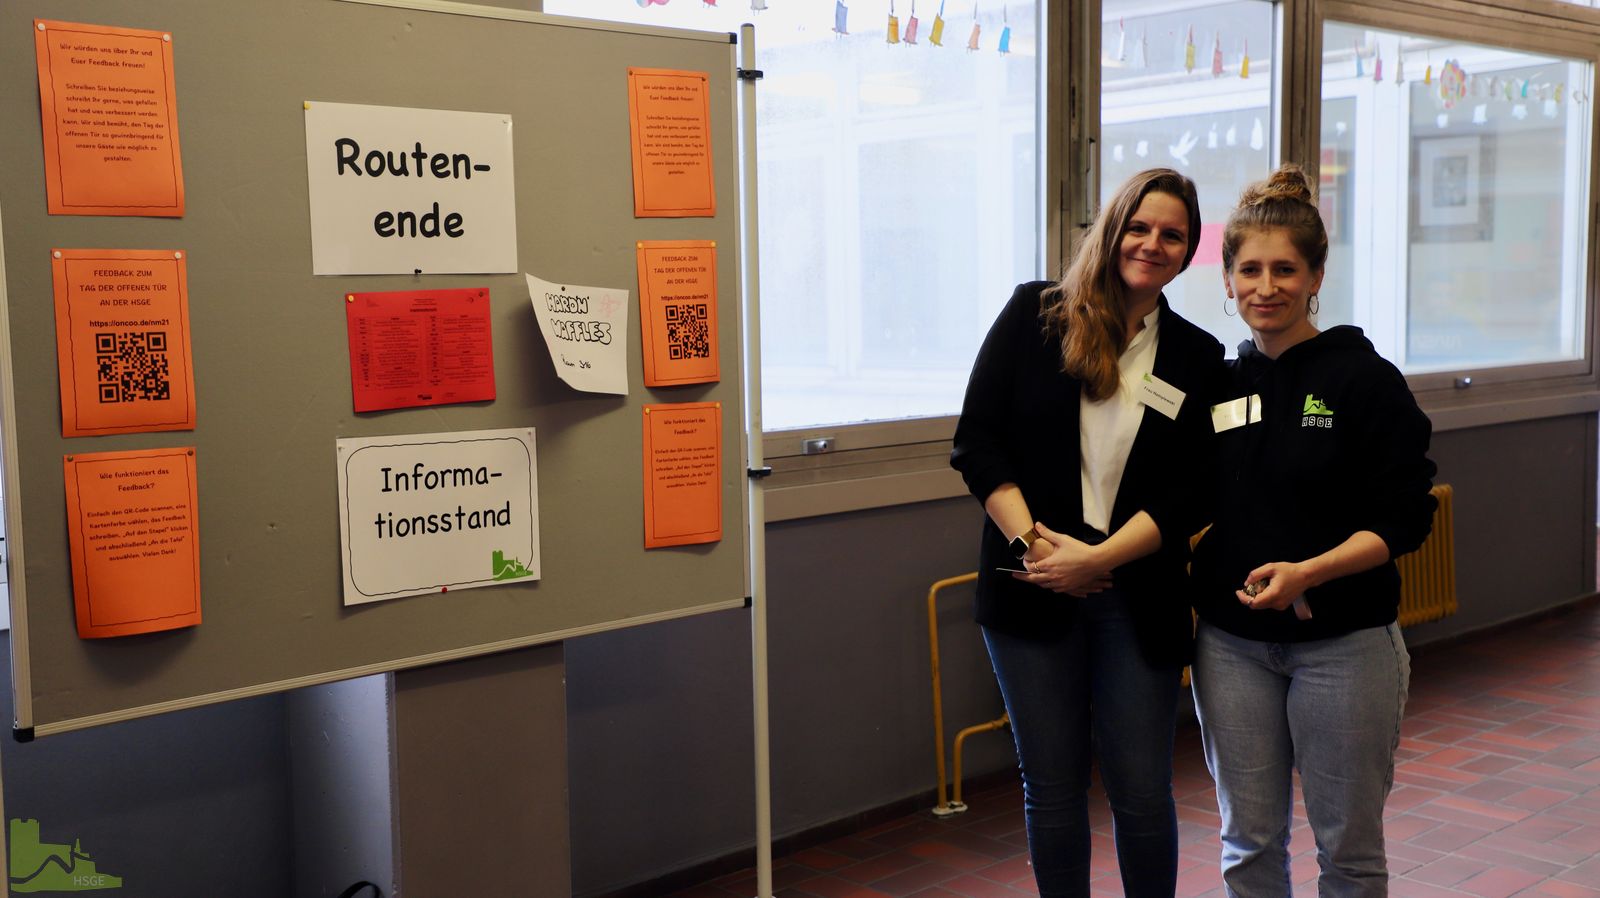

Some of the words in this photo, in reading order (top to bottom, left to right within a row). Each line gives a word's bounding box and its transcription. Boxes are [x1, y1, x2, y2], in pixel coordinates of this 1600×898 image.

[88, 58, 120, 67] Feedback
[335, 138, 490, 180] Routen-
[374, 202, 464, 238] ende
[1302, 416, 1332, 428] HSGE
[114, 470, 156, 479] funktioniert
[381, 463, 502, 492] Informa-
[118, 483, 155, 492] Feedback?
[374, 500, 510, 538] tionsstand
